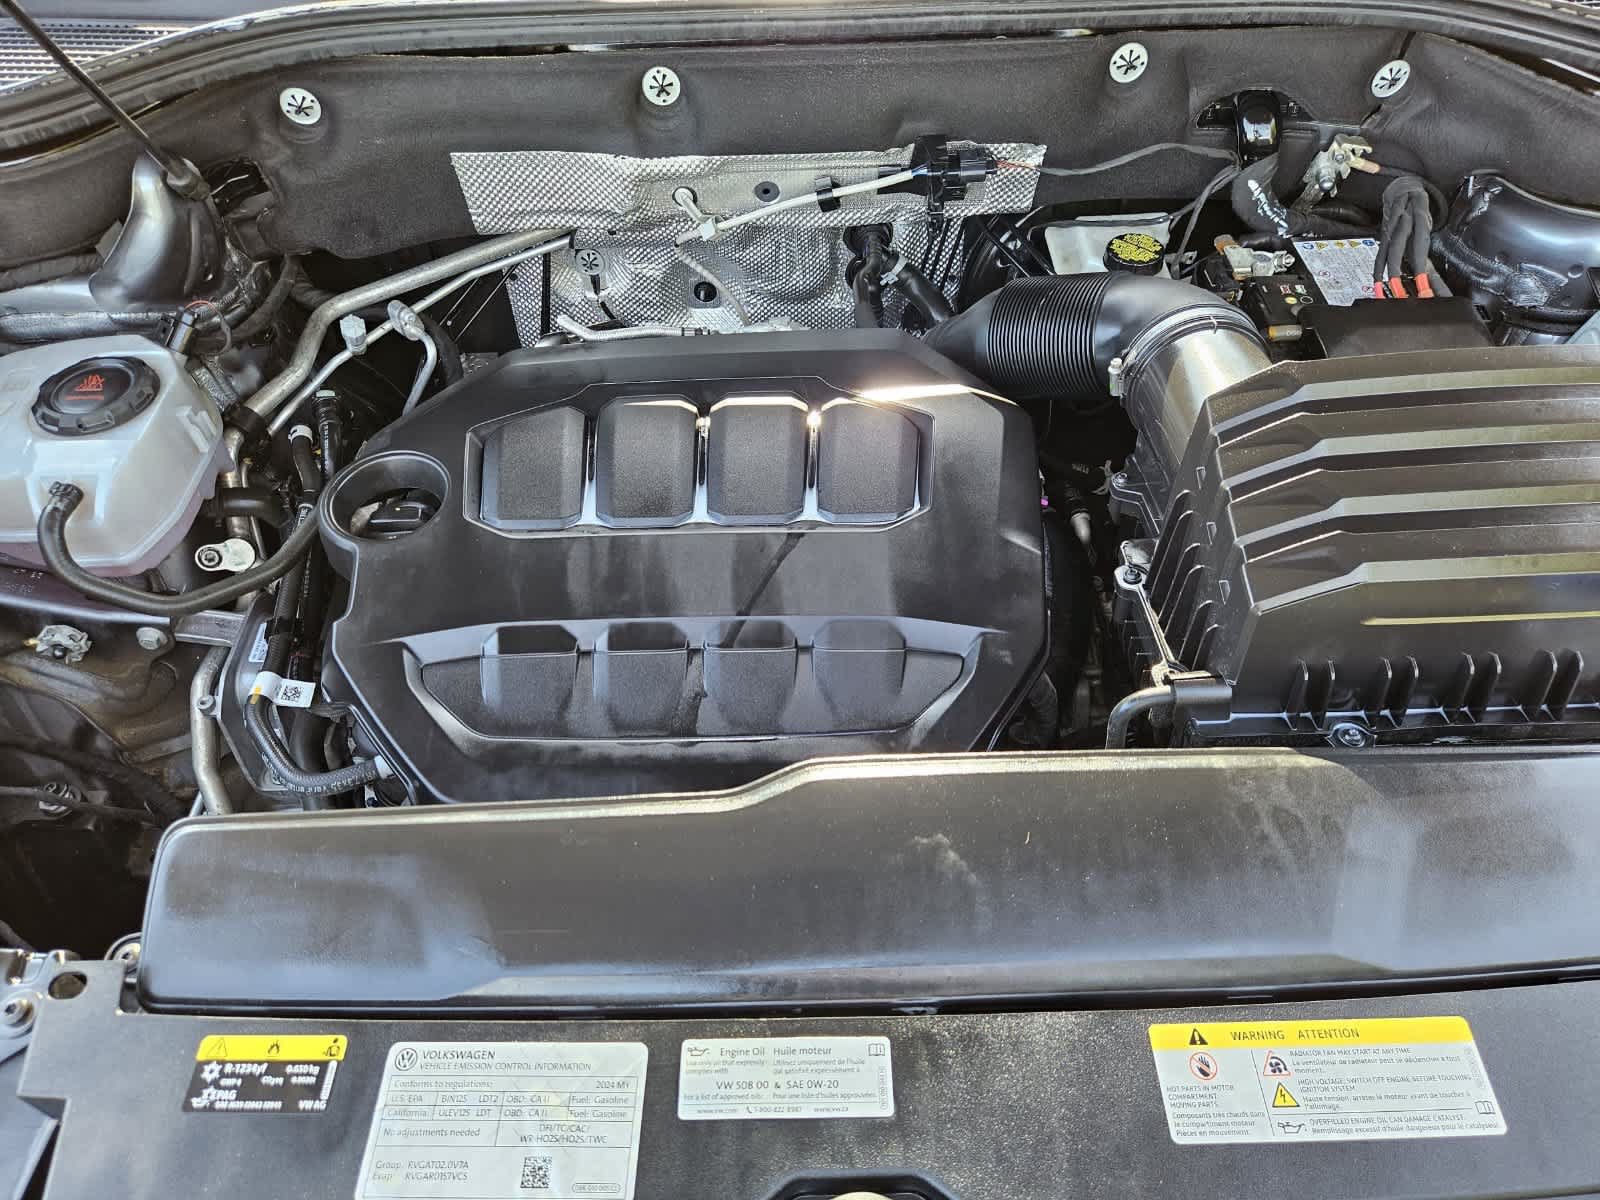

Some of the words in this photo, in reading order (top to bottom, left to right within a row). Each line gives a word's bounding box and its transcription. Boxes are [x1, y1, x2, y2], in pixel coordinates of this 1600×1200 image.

[1230, 1031, 1285, 1042] WARNING
[1298, 1029, 1360, 1040] ATTENTION
[422, 1050, 496, 1060] VOLKSWAGEN
[720, 1048, 750, 1059] Engine
[752, 1048, 765, 1057] Oil
[773, 1047, 797, 1057] Huile
[799, 1047, 832, 1055] moteur
[223, 1063, 269, 1077] R-1234yf
[419, 1062, 451, 1072] VEHICLE
[453, 1062, 493, 1072] EMISSION
[495, 1062, 532, 1072] CONTROL
[533, 1062, 592, 1073] INFORMATION
[393, 1079, 433, 1088] Conforms
[434, 1080, 443, 1089] to
[595, 1080, 616, 1090] 2024
[617, 1080, 631, 1090] MY
[715, 1081, 735, 1090] VW
[736, 1081, 754, 1090] 508
[755, 1081, 769, 1090] 00
[774, 1081, 782, 1089] &
[786, 1080, 805, 1090] SAE
[806, 1080, 840, 1090] 0W-20
[441, 1095, 467, 1104] BIN125
[478, 1095, 499, 1104] LDT2
[530, 1096, 542, 1105] CA
[571, 1096, 591, 1106] Fuel:
[593, 1096, 629, 1106] Gasoline
[438, 1108, 471, 1118] ULEV125
[476, 1108, 493, 1118] LDT
[528, 1109, 541, 1118] CA
[570, 1109, 589, 1119] Fuel:
[592, 1110, 628, 1120] Gasoline
[383, 1127, 395, 1138] No
[397, 1127, 449, 1139] adjustments
[450, 1127, 481, 1137] needed
